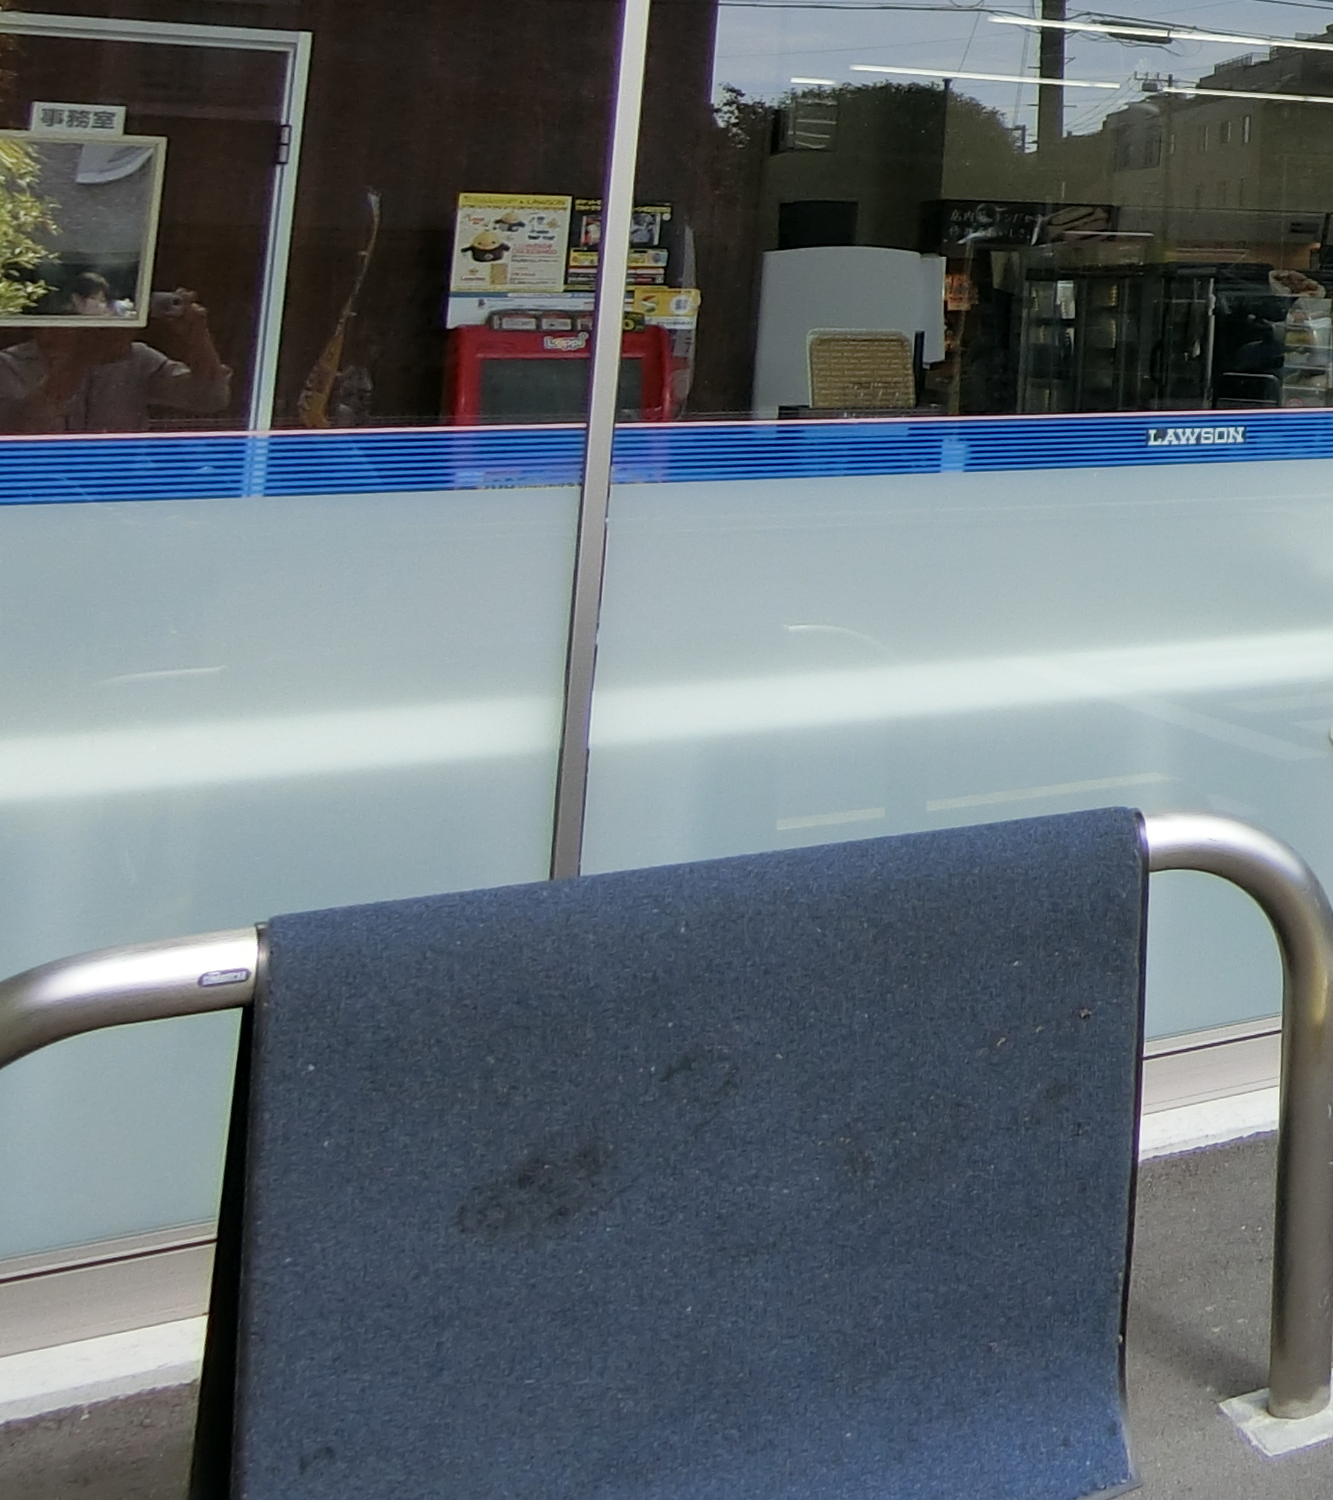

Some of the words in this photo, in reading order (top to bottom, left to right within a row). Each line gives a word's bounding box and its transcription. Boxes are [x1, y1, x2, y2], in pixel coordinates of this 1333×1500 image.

[41, 107, 116, 130] 事務室
[1147, 426, 1246, 446] LAWSON
